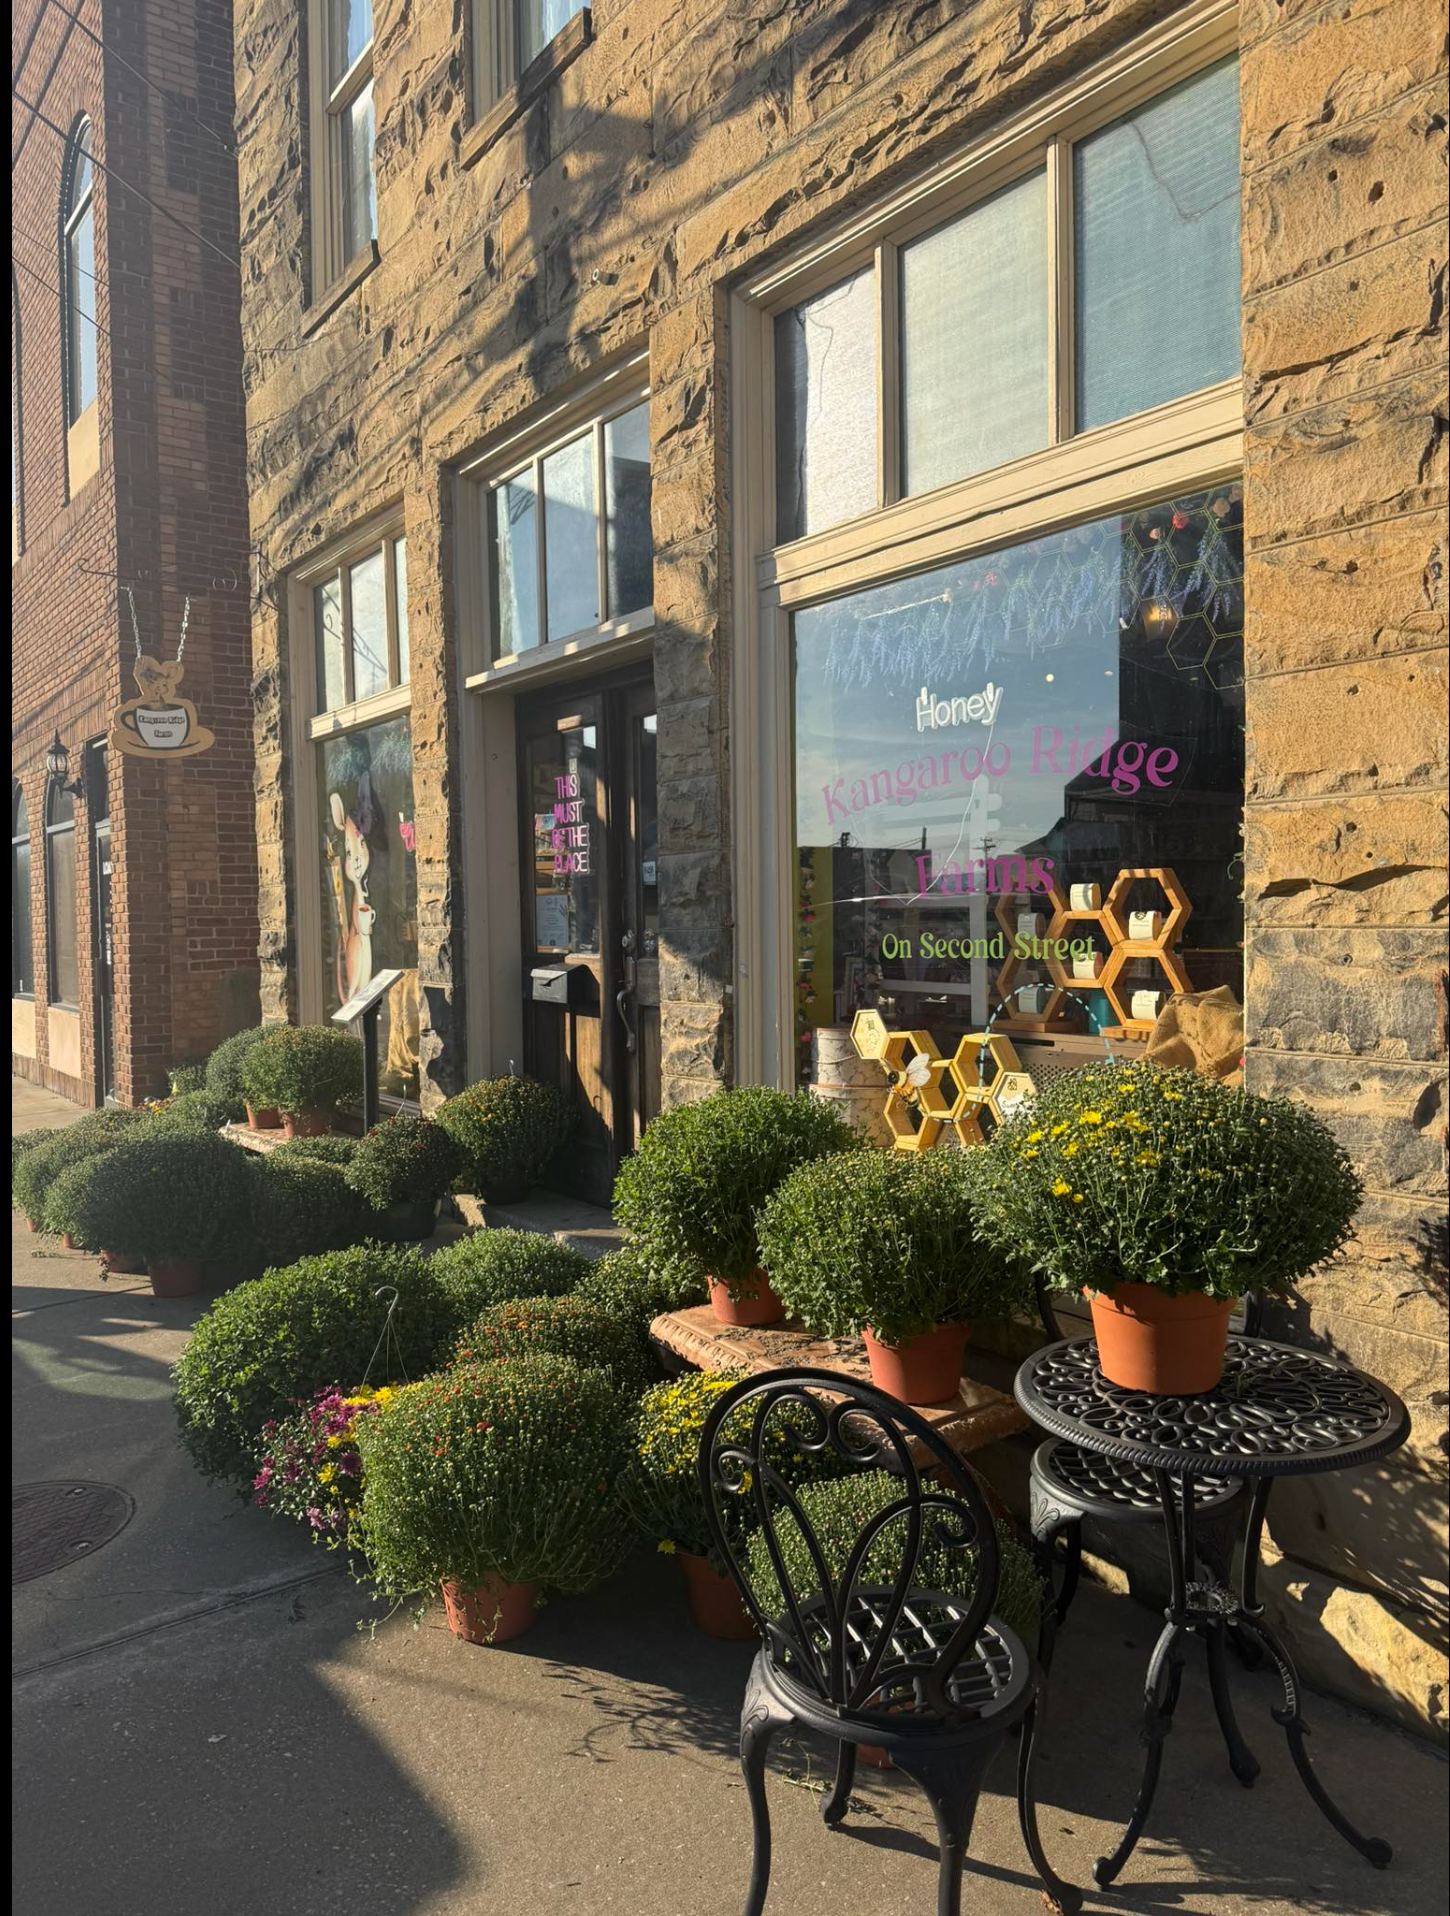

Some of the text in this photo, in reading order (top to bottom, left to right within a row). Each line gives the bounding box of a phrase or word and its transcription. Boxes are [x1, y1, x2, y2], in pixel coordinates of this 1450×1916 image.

[916, 684, 1003, 732] Honey
[554, 774, 578, 799] THIS
[821, 723, 1179, 825] Kangaroo Ridge
[553, 800, 583, 824] MUST
[551, 825, 588, 850] BE THE
[554, 852, 588, 873] PLACE
[915, 853, 1055, 899] Farms
[882, 931, 1095, 961] On Second Street
